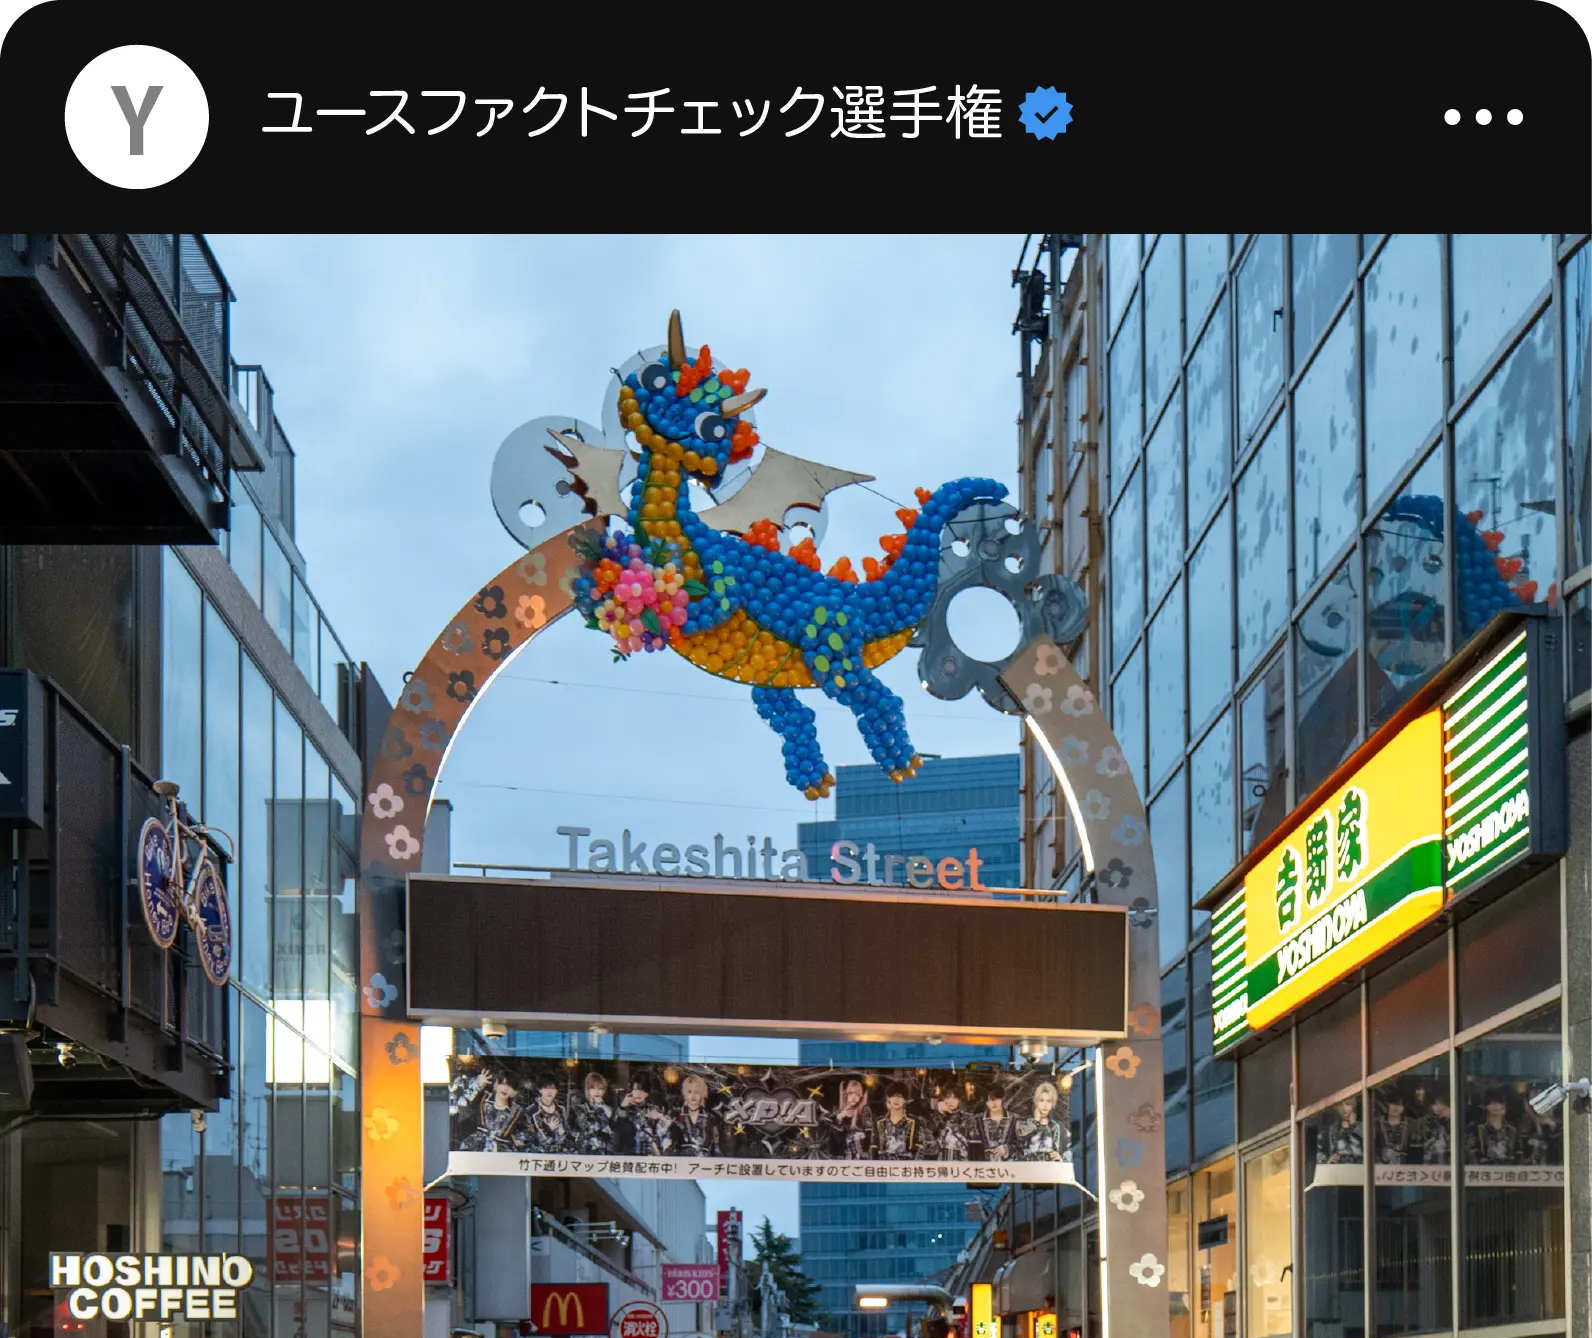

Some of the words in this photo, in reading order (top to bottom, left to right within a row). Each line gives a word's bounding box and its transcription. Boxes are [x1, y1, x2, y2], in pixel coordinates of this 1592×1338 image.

[1447, 788, 1530, 872] YOSHINOYA
[557, 826, 808, 882] Takeshita
[830, 839, 986, 891] Street
[1277, 789, 1366, 931] 吉野家
[1277, 888, 1368, 985] YOSHINOYA
[688, 1161, 1017, 1181] アーチに設置していますのでご自由にお持ち帰りください。
[51, 1254, 253, 1287] HOSHINO
[69, 1288, 237, 1320] COFFEE
[666, 1279, 714, 1299] ¥300
[623, 1321, 657, 1337] 消火栓
